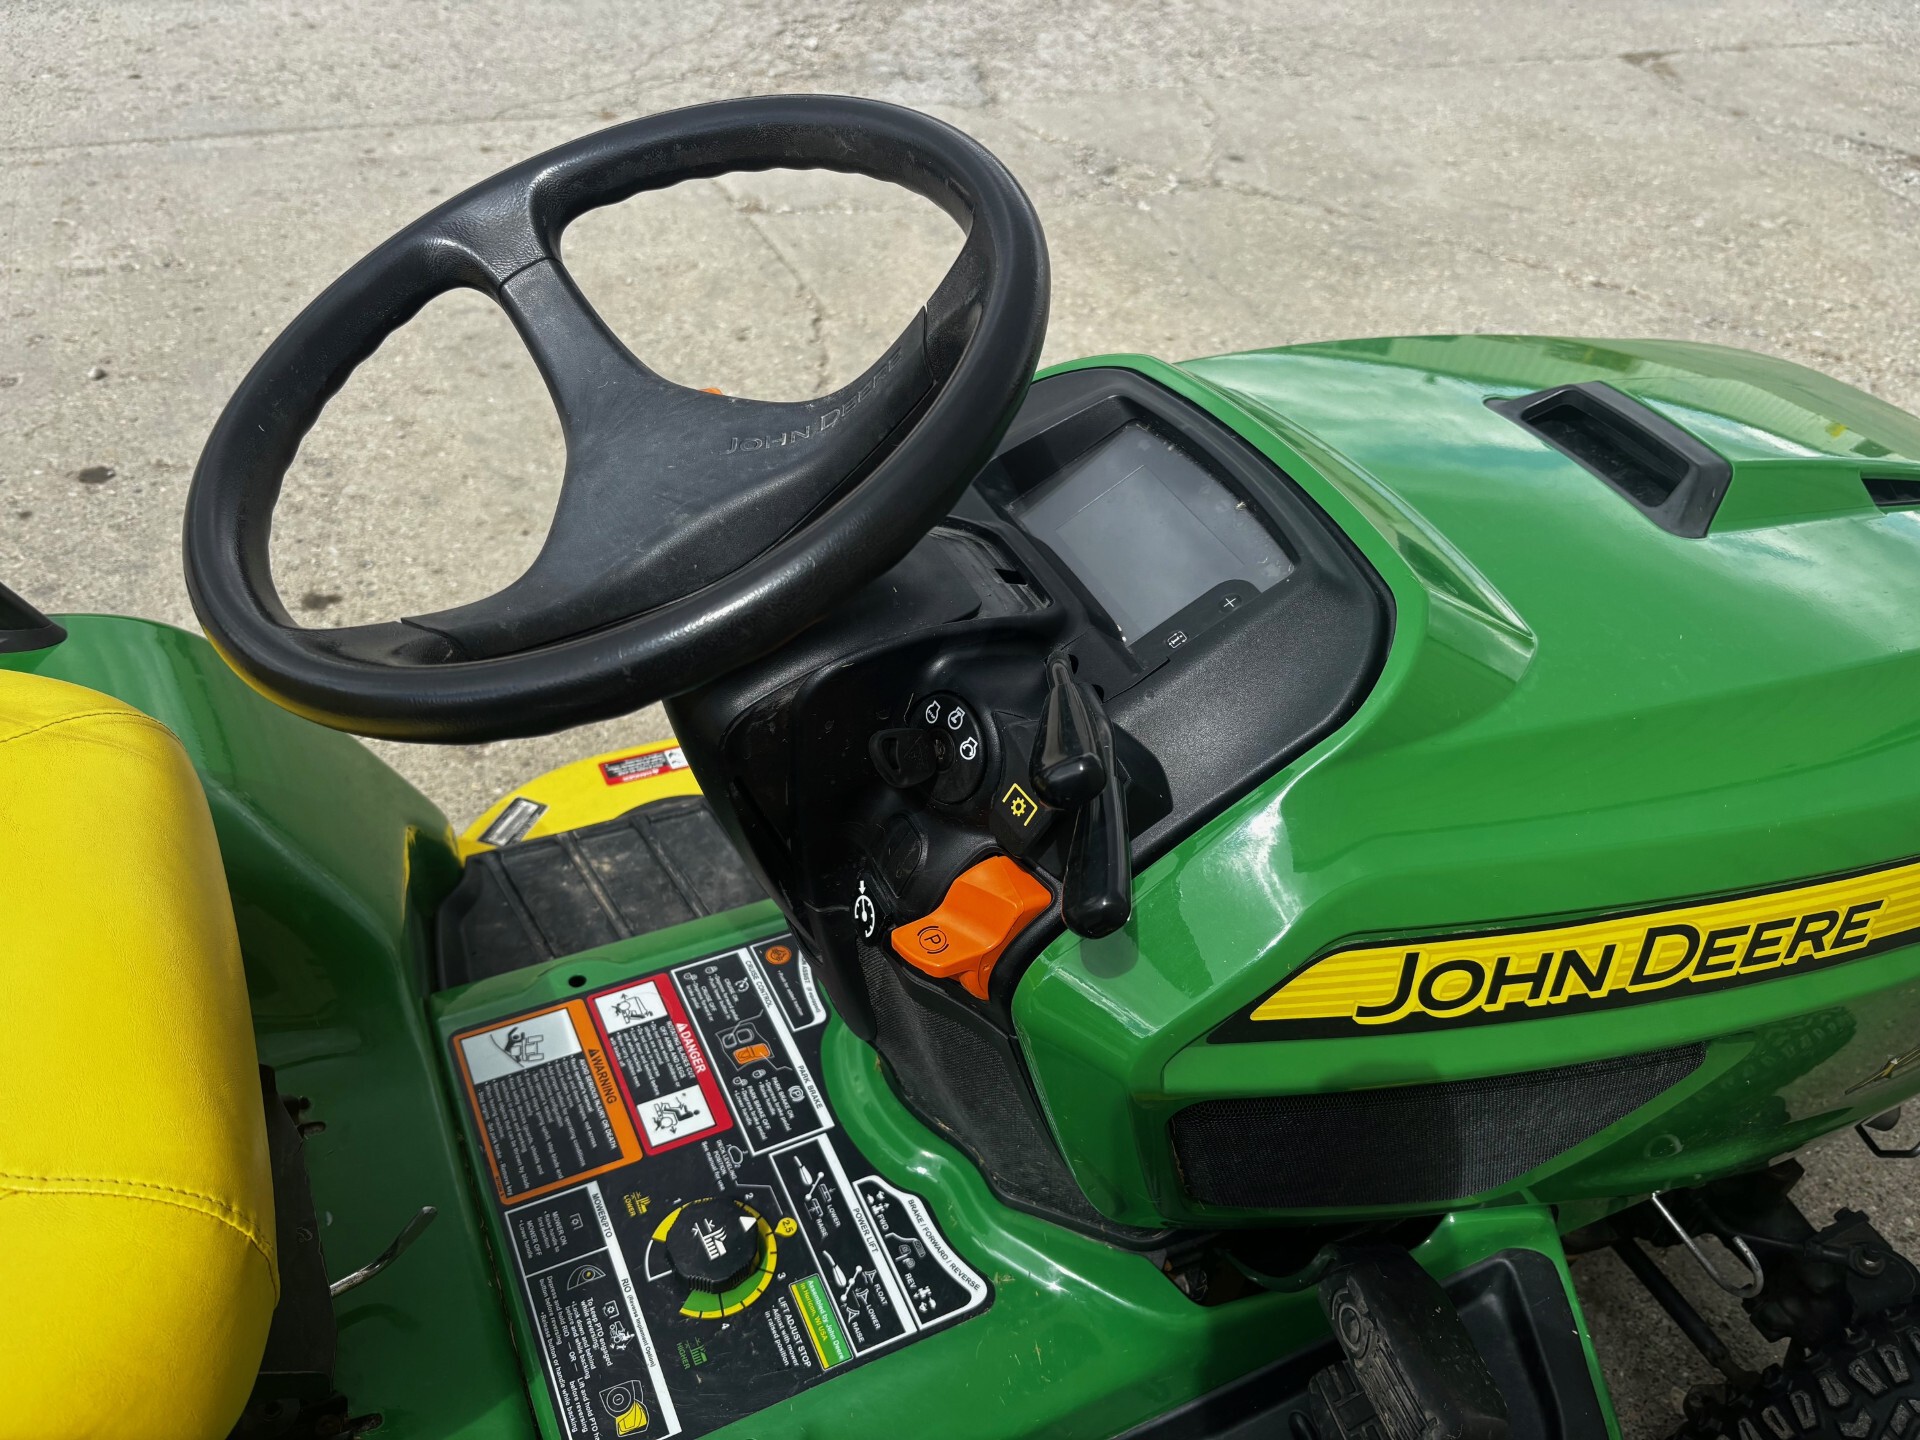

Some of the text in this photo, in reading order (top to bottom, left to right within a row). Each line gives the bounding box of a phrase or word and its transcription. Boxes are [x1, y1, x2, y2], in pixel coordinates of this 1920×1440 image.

[724, 346, 903, 455] JOHN DEERE
[1354, 899, 1886, 1020] JOHN DEERE
[744, 960, 773, 1007] CRUISE CONTROL
[680, 1030, 706, 1073] DANGER
[591, 1055, 617, 1104] WARNING
[797, 1065, 823, 1108] PARK BRAKE
[592, 1192, 612, 1238] MOWER/PTO
[622, 1194, 636, 1217] LOWER
[826, 1204, 841, 1226] LOWER
[551, 1210, 567, 1245] MOWER ON
[781, 1219, 793, 1233] 2.5
[815, 1218, 828, 1237] RAISE
[852, 1207, 878, 1253] POWER LIFT
[876, 1213, 889, 1230] FWD
[526, 1219, 542, 1256] MOWER OFF
[907, 1199, 923, 1223] BRAKE
[922, 1226, 950, 1260] FORWARD
[948, 1263, 980, 1291] REVERSE
[775, 1271, 786, 1280] 3
[904, 1272, 916, 1289] REV
[545, 1275, 569, 1337] Depress and hold RIO
[802, 1289, 817, 1316] Horicon,
[873, 1283, 887, 1305] FLOAT
[539, 1278, 563, 1345] button before reversing
[580, 1299, 590, 1317] while
[807, 1279, 845, 1359] Assembled by John Deere
[813, 1315, 822, 1326] WI
[865, 1304, 881, 1329] LOWER
[540, 1313, 552, 1338] Release
[586, 1297, 612, 1367] To keep PTO engaged
[620, 1277, 656, 1368] RIO (Reverse Implement Option)
[720, 1322, 730, 1330] 4
[777, 1296, 811, 1368] LIFT ADJUST STOP
[817, 1325, 828, 1341] USA
[851, 1321, 864, 1342] RAISE
[547, 1338, 558, 1359] button
[565, 1305, 592, 1379] before and while backing
[571, 1303, 596, 1370] Look down and behind
[764, 1310, 790, 1366] in raised position
[771, 1307, 799, 1366] Adjust with mower
[568, 1350, 576, 1362] OR
[675, 1342, 690, 1370] HIGHER
[555, 1366, 566, 1388] handle
[576, 1377, 585, 1389] Lift
[561, 1388, 571, 1406] while
[568, 1380, 589, 1433] before reversing
[580, 1388, 589, 1402] and
[584, 1401, 593, 1416] hold
[565, 1405, 579, 1433] backing
[588, 1416, 598, 1432] PTO
